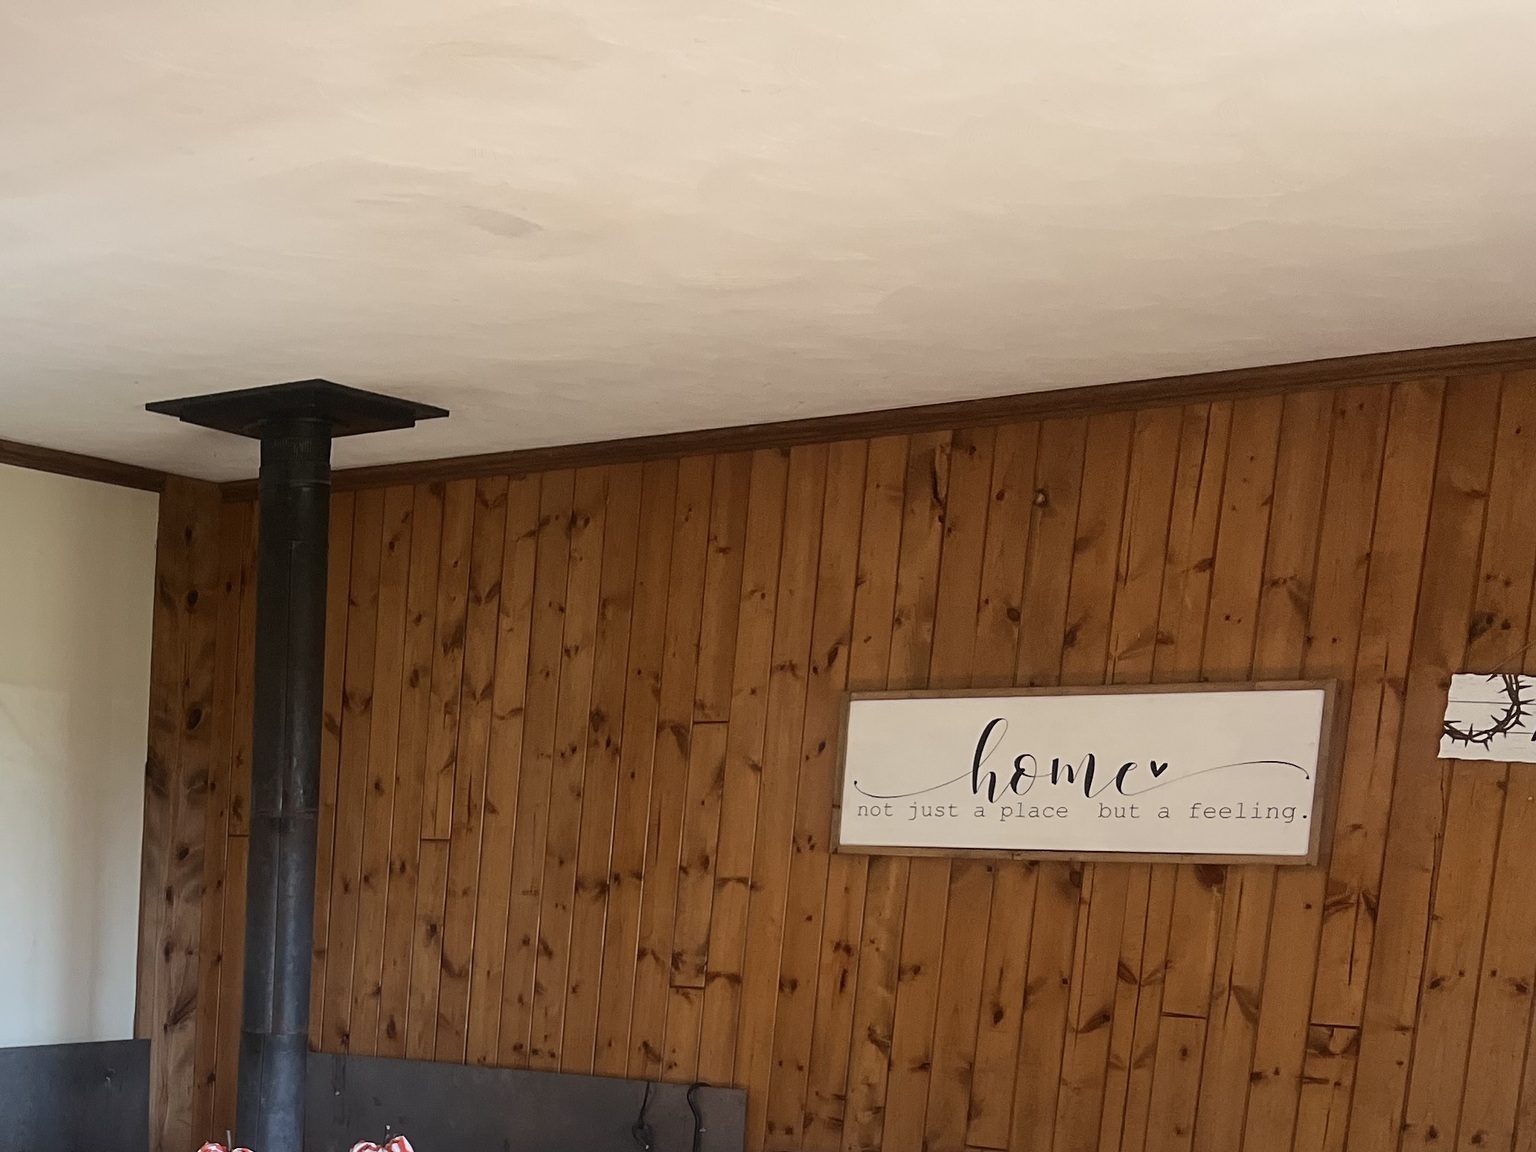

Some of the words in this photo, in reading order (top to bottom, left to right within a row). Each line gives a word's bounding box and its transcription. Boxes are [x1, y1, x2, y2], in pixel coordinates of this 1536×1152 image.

[970, 717, 1141, 803] home
[856, 802, 894, 818] not
[907, 801, 959, 821] just
[973, 806, 987, 819] a
[999, 802, 1069, 824] place
[1097, 803, 1141, 820] but
[1157, 807, 1171, 820] a
[1189, 802, 1309, 823] feeling.
